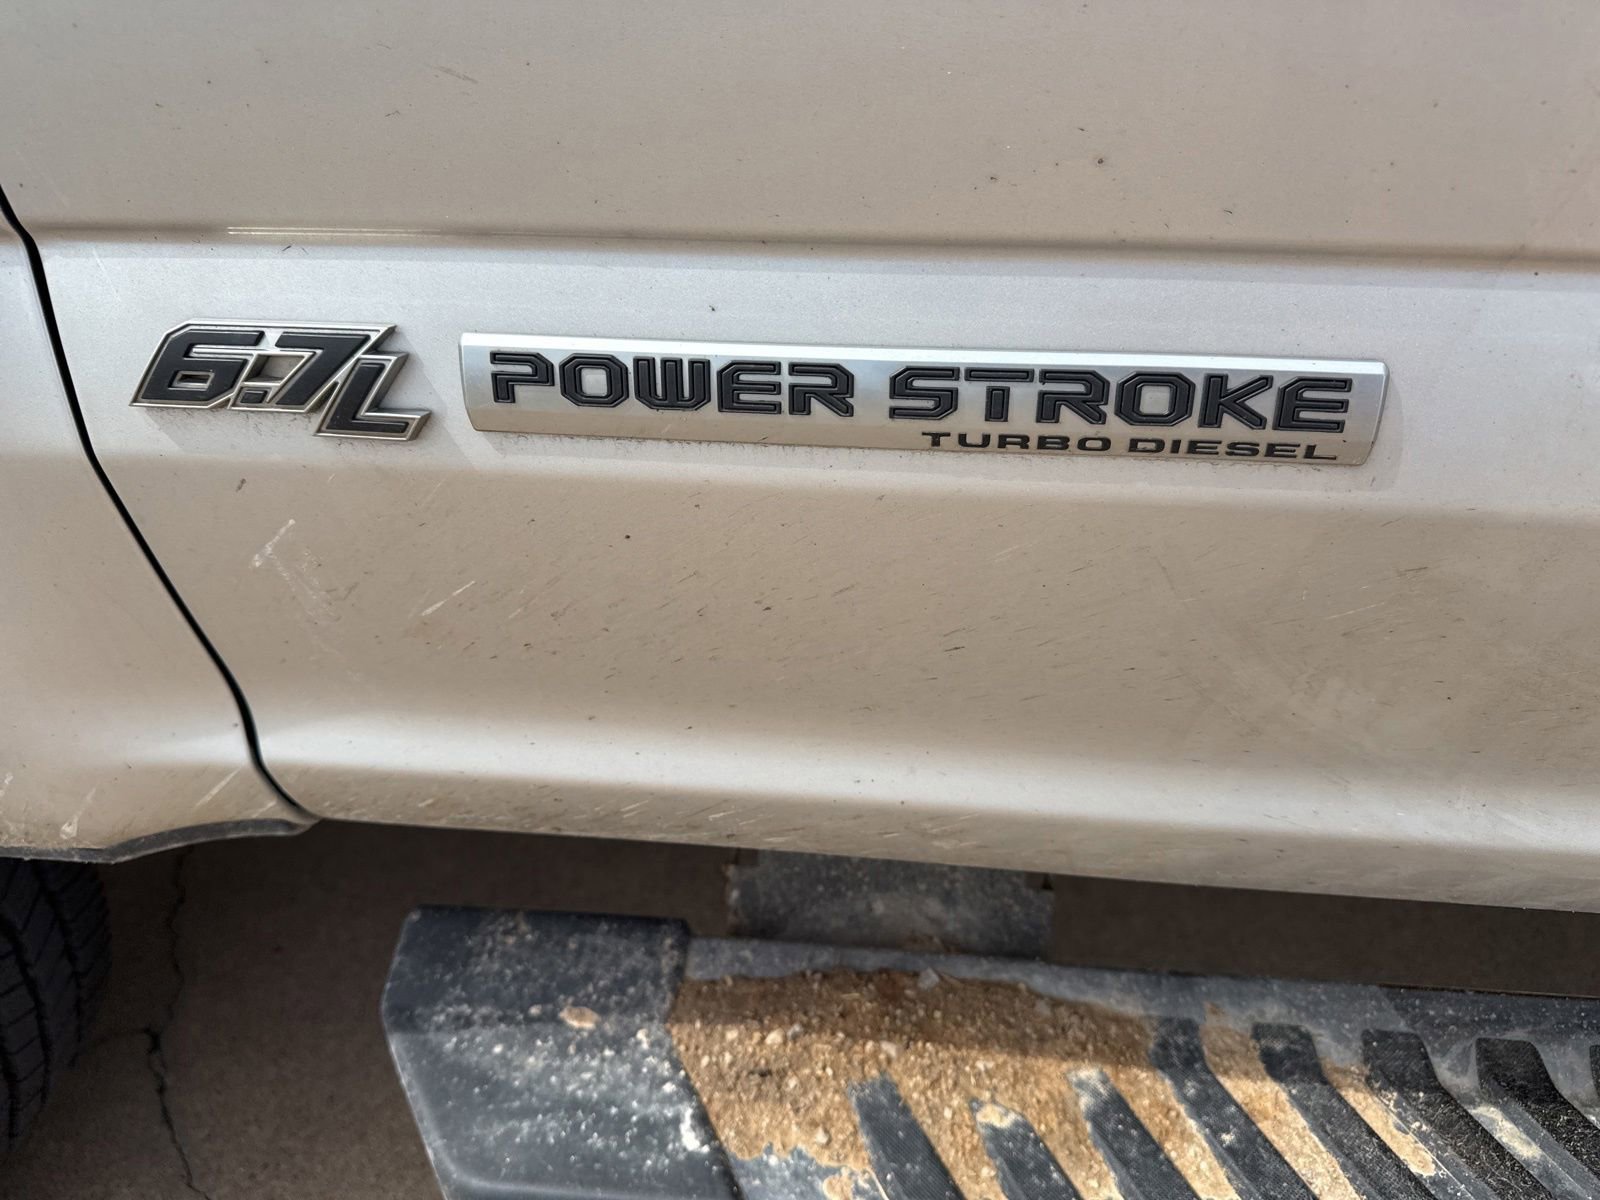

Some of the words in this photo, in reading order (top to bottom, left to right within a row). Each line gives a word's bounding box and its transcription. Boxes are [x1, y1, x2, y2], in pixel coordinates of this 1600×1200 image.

[131, 319, 430, 440] 6.7L
[489, 350, 855, 418] POWER
[889, 365, 1353, 433] STROKE
[921, 431, 1112, 452] TURBO
[1127, 437, 1338, 461] DIESEL
